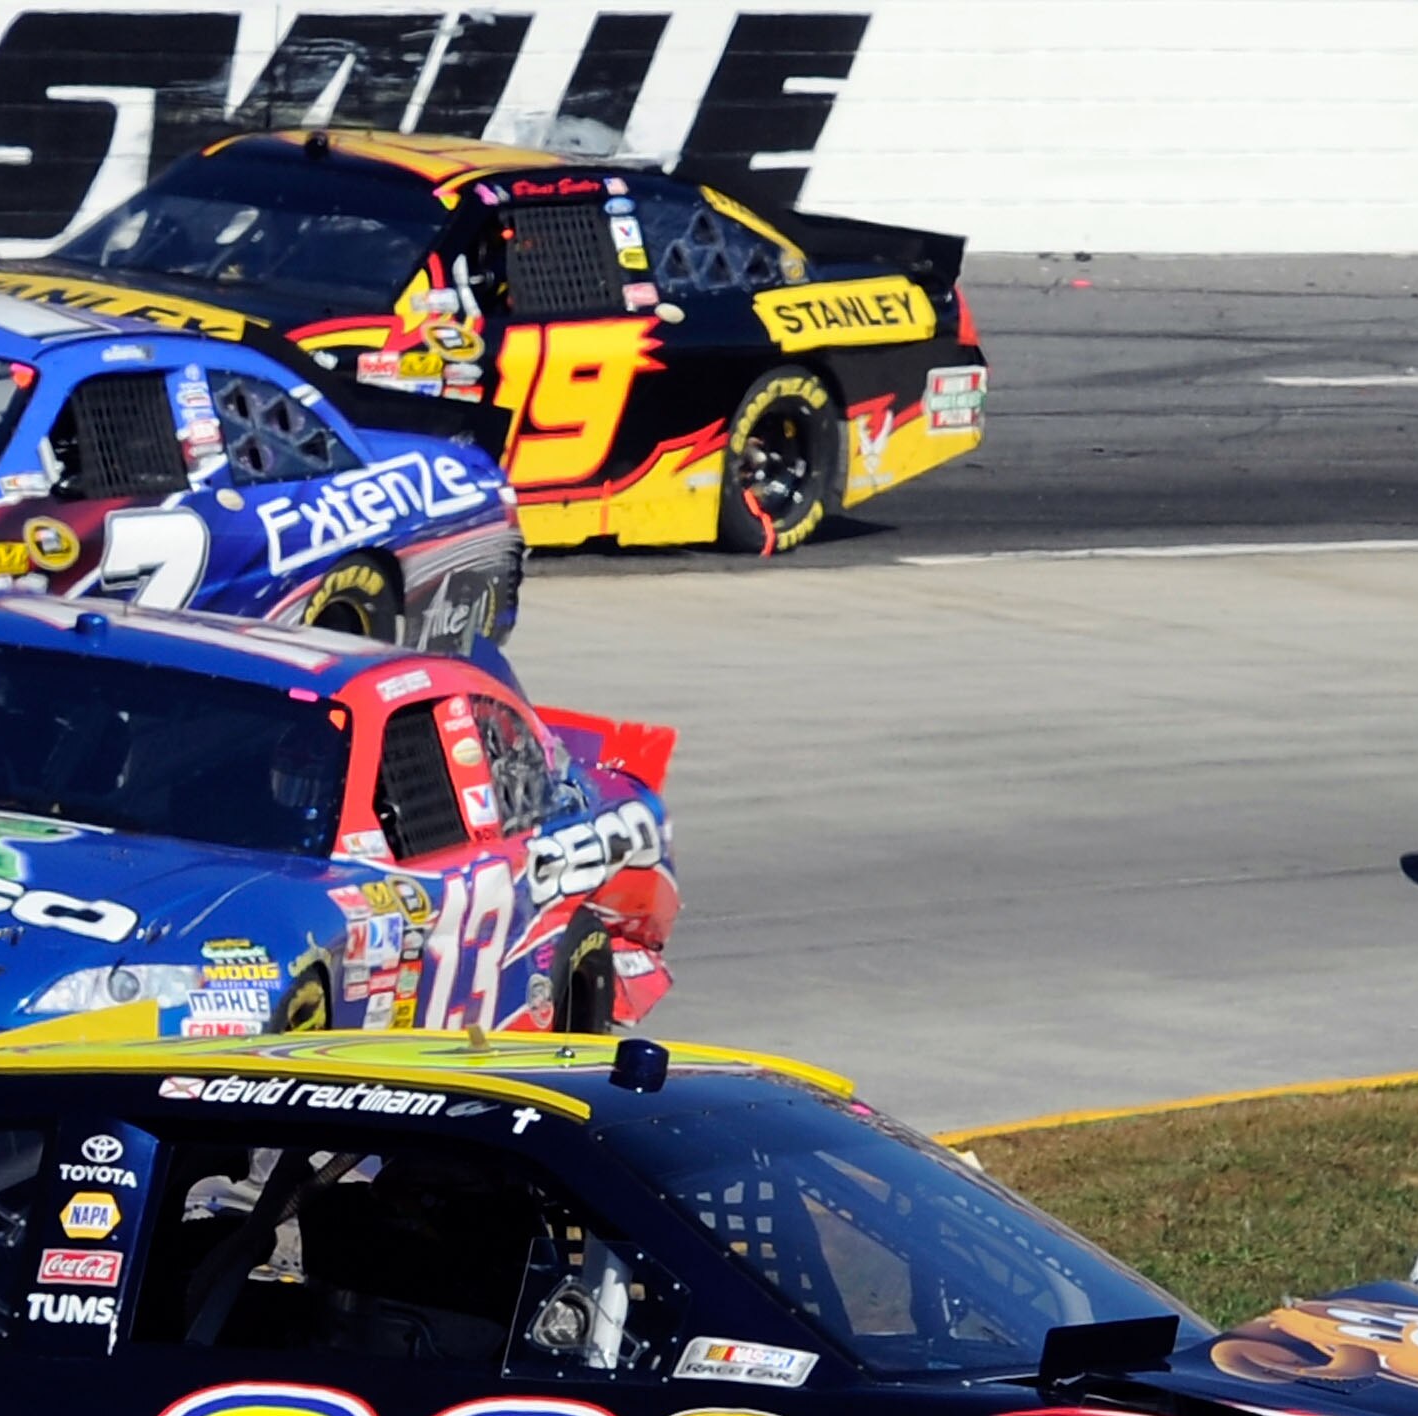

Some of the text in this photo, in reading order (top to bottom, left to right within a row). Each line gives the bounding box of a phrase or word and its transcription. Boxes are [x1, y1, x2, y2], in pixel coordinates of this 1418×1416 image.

[773, 290, 917, 334] STANLEY
[496, 318, 666, 484] 19
[100, 507, 210, 609] 7
[425, 857, 515, 1031] 13
[203, 964, 279, 980] MOOG
[189, 991, 268, 1012] MAHLE
[201, 1075, 447, 1116] david reutimann
[59, 1164, 137, 1188] TOYOTA
[69, 1205, 110, 1227] NAPA
[27, 1293, 116, 1325] TUMS
[730, 1346, 792, 1368] NASCAR
[685, 1363, 793, 1382] RACE CAR
